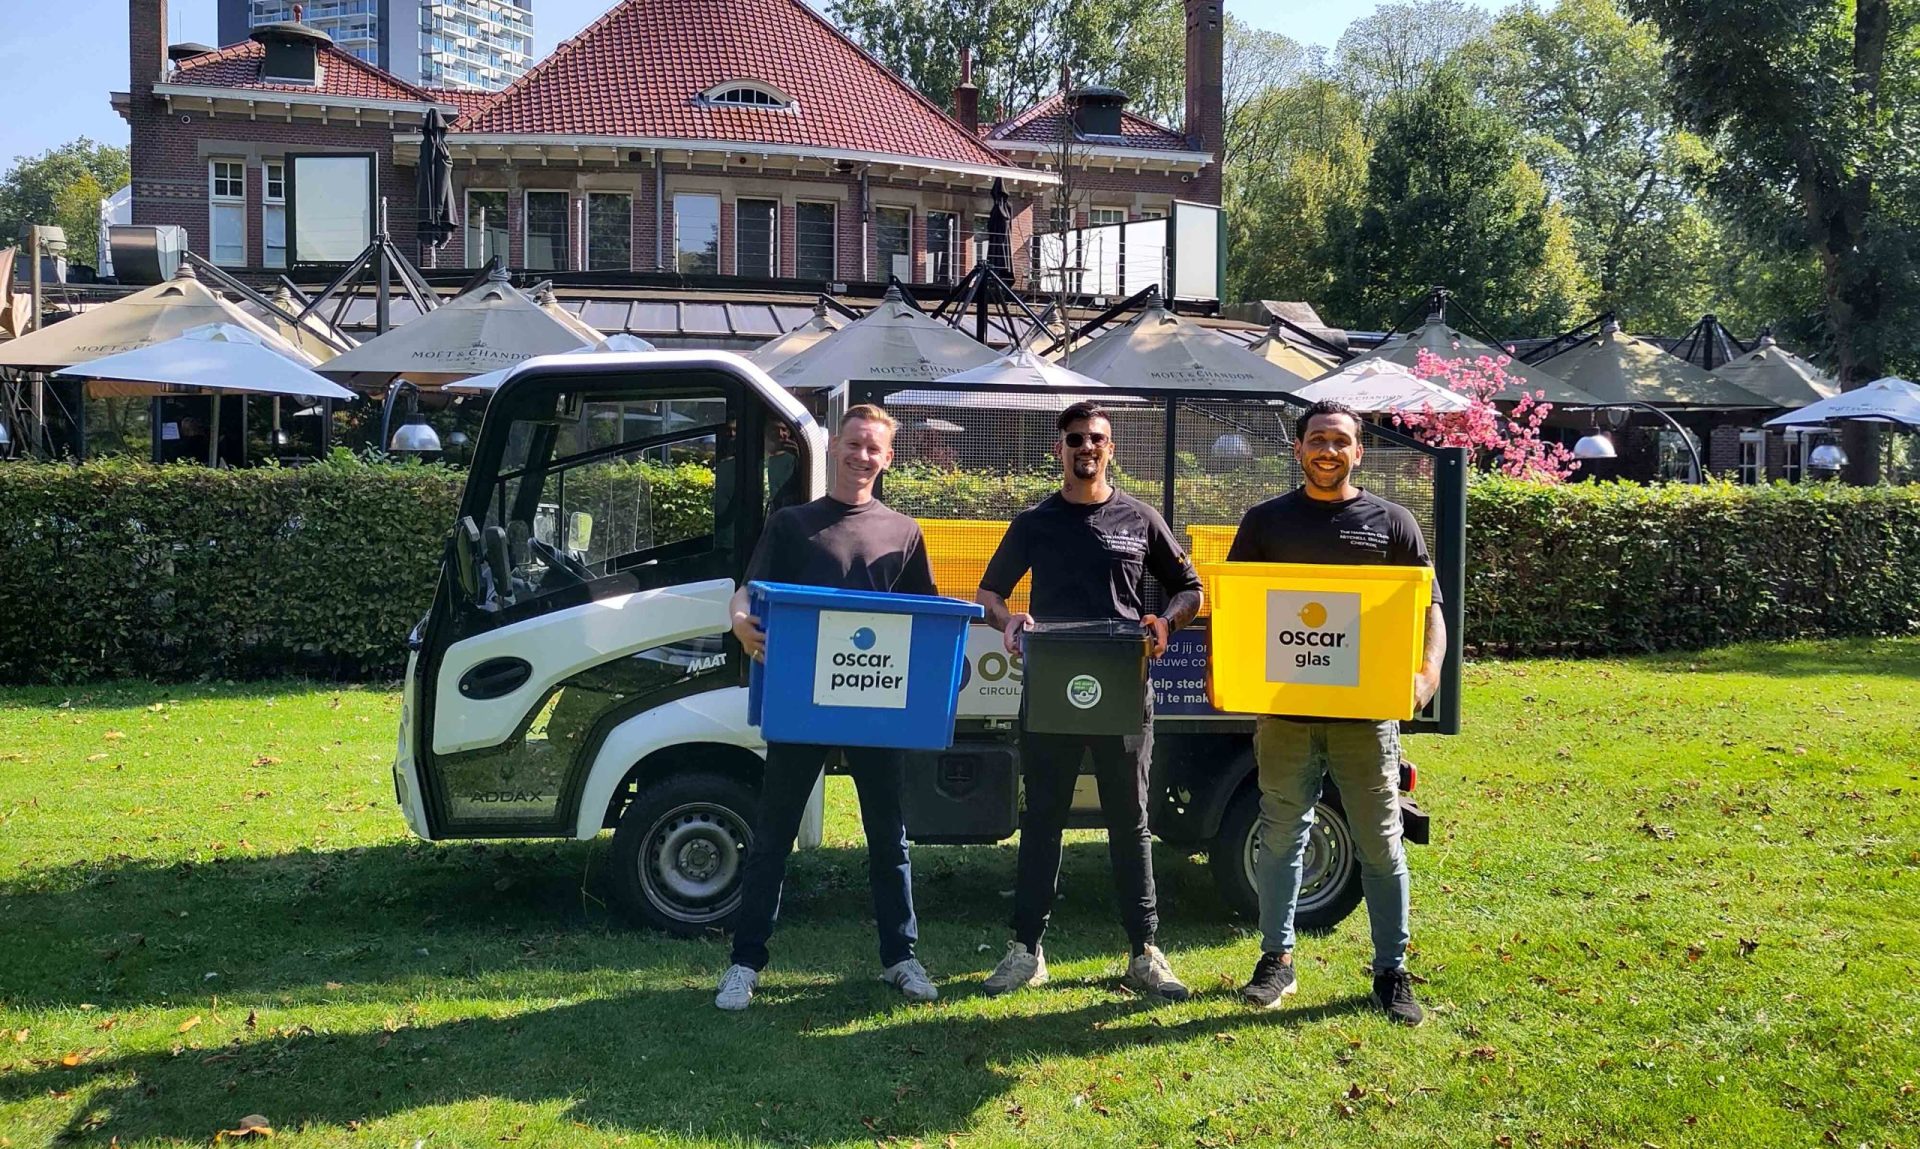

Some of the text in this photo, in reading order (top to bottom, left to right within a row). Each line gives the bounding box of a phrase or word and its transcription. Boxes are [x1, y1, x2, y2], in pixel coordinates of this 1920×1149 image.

[920, 364, 970, 375] CHAND
[1166, 642, 1179, 653] rd
[1182, 642, 1192, 654] jij
[686, 652, 727, 673] MAAT
[832, 652, 894, 669] oscar.
[1295, 650, 1331, 668] glas
[977, 651, 1024, 682] OS
[831, 670, 903, 692] papier
[1153, 678, 1173, 691] elp
[979, 686, 1020, 696] CIRCUL
[1168, 693, 1180, 703] te
[1184, 693, 1209, 703] mak
[469, 790, 543, 803] ADDAX
